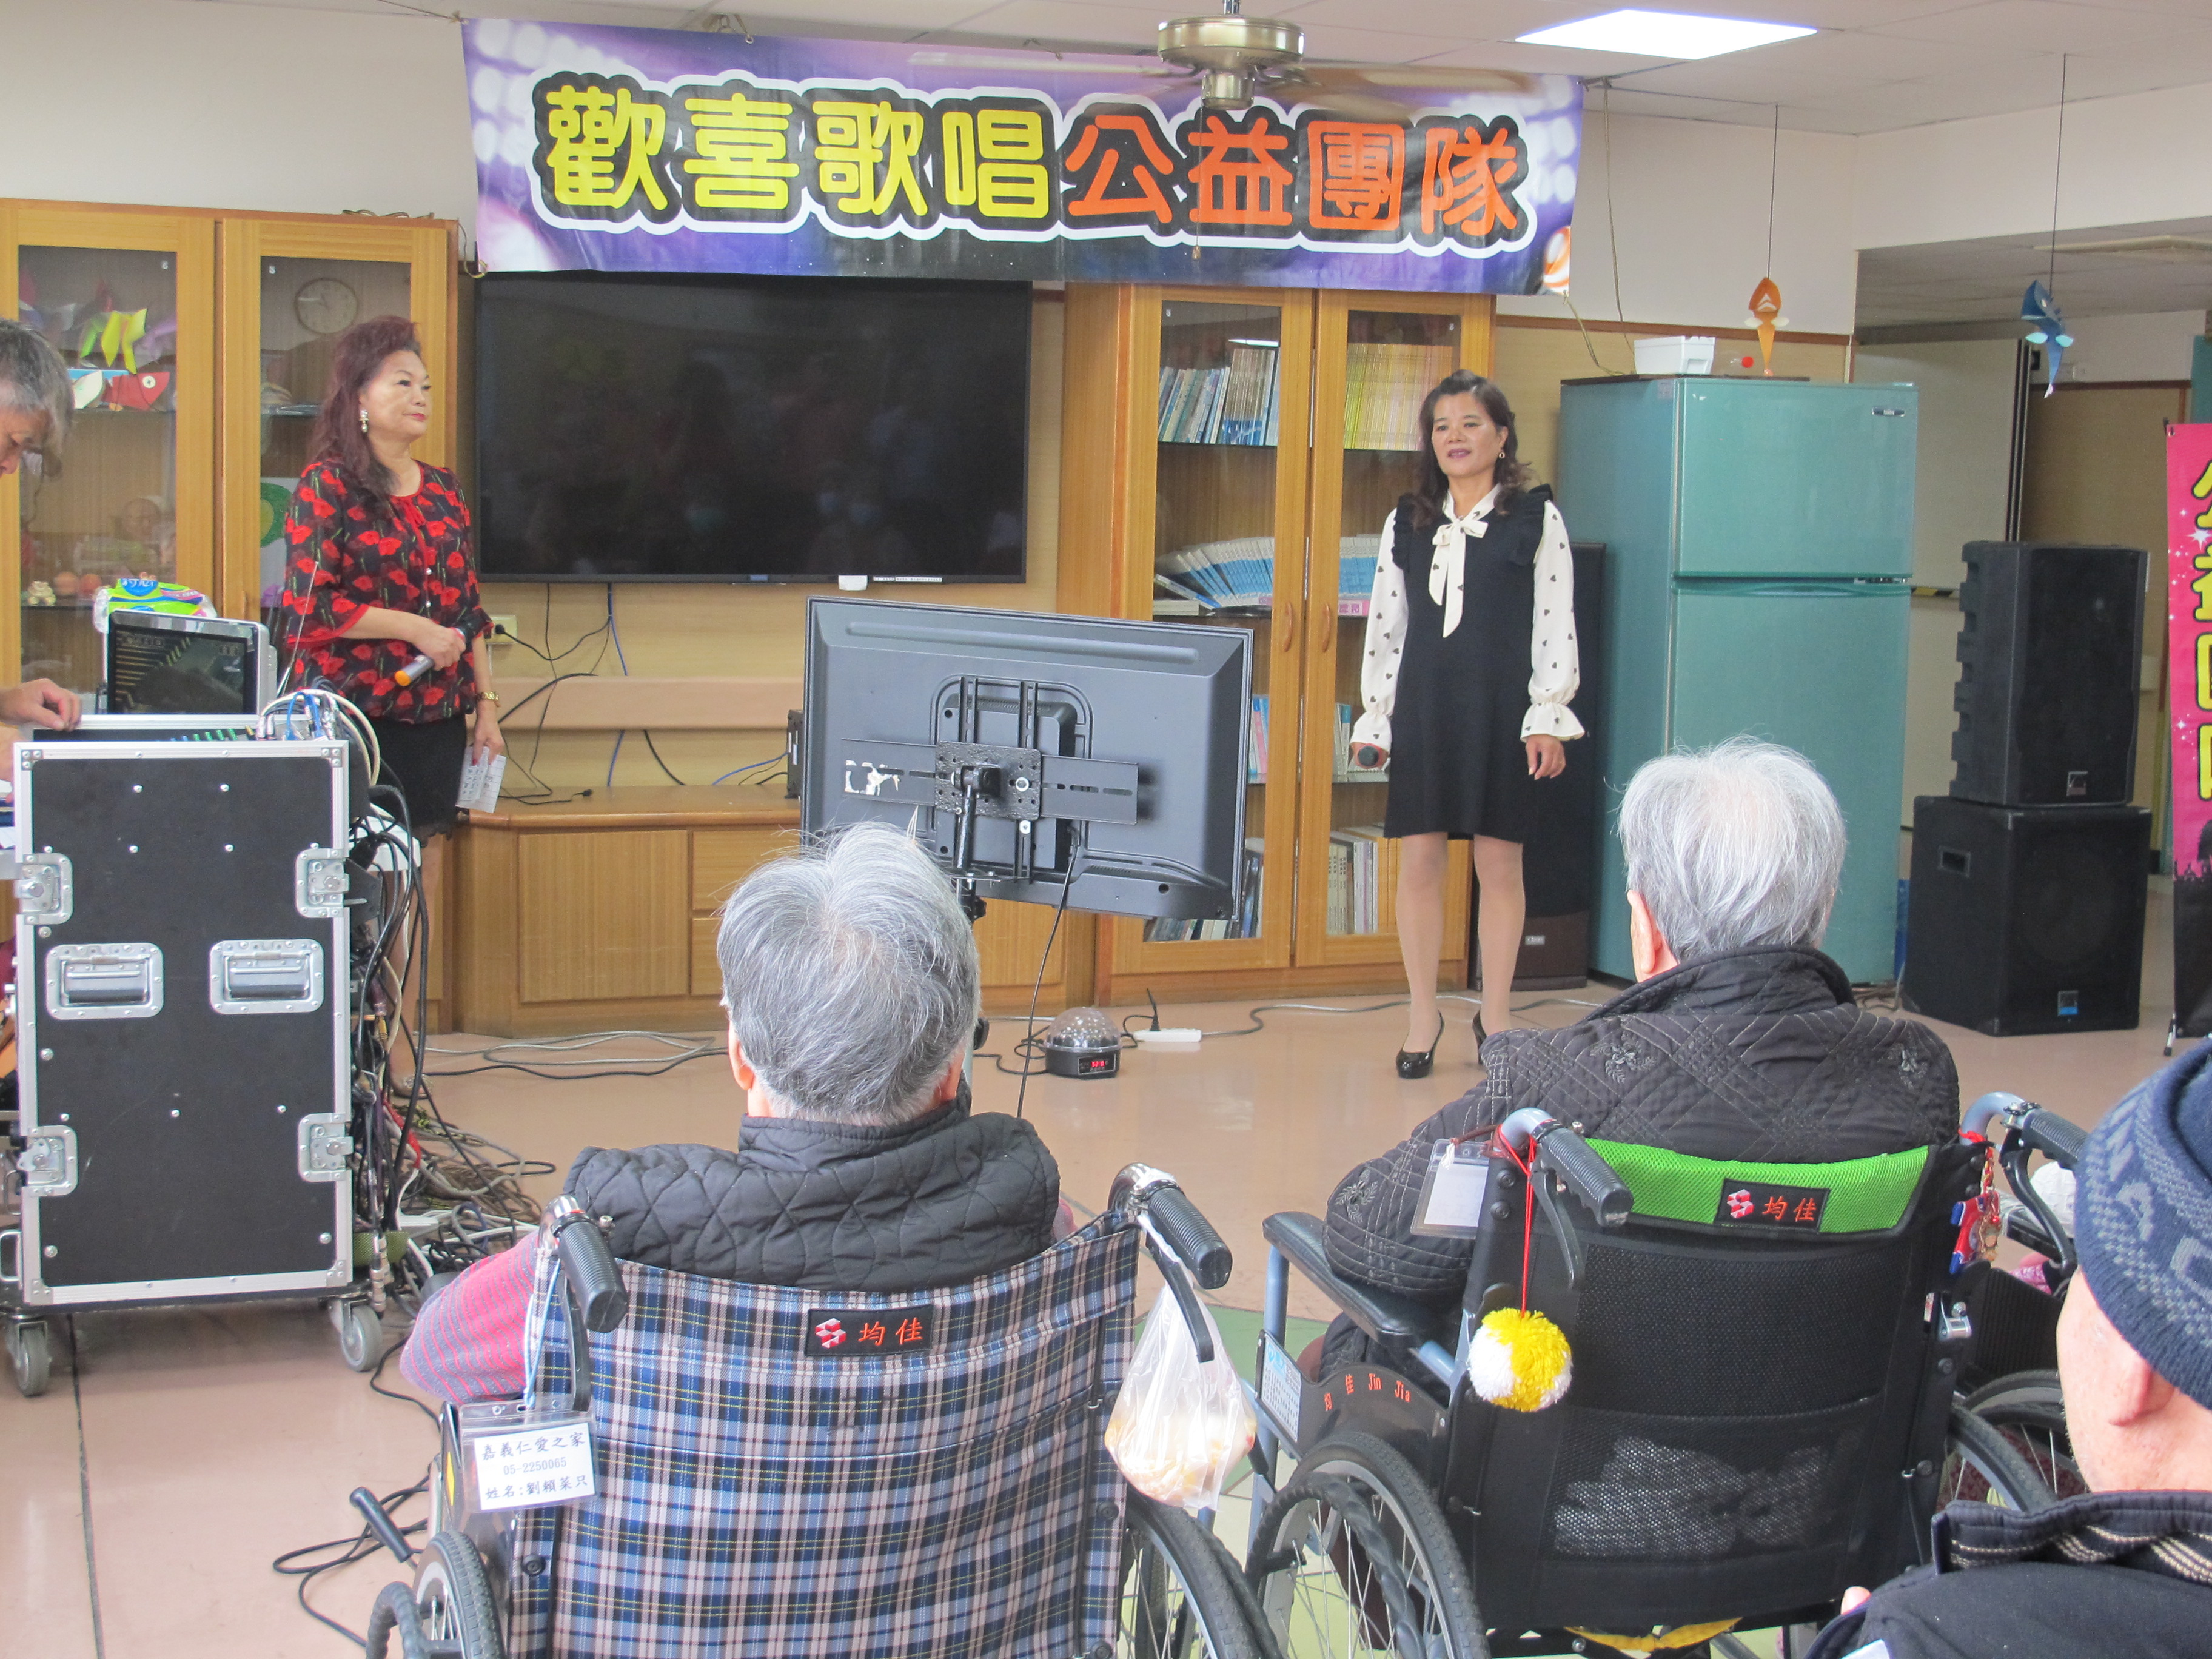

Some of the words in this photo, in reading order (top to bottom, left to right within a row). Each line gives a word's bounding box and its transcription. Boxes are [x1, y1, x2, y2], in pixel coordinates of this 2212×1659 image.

[546, 85, 1518, 236] 歡喜歌唱公益團隊
[1762, 1196, 1817, 1222] 均佳
[858, 1317, 923, 1346] 均佳
[1368, 1373, 1382, 1390] Jin
[1395, 1379, 1410, 1402] Jia
[481, 1432, 585, 1460] 嘉義仁愛之家
[503, 1456, 567, 1475] 05-2250065
